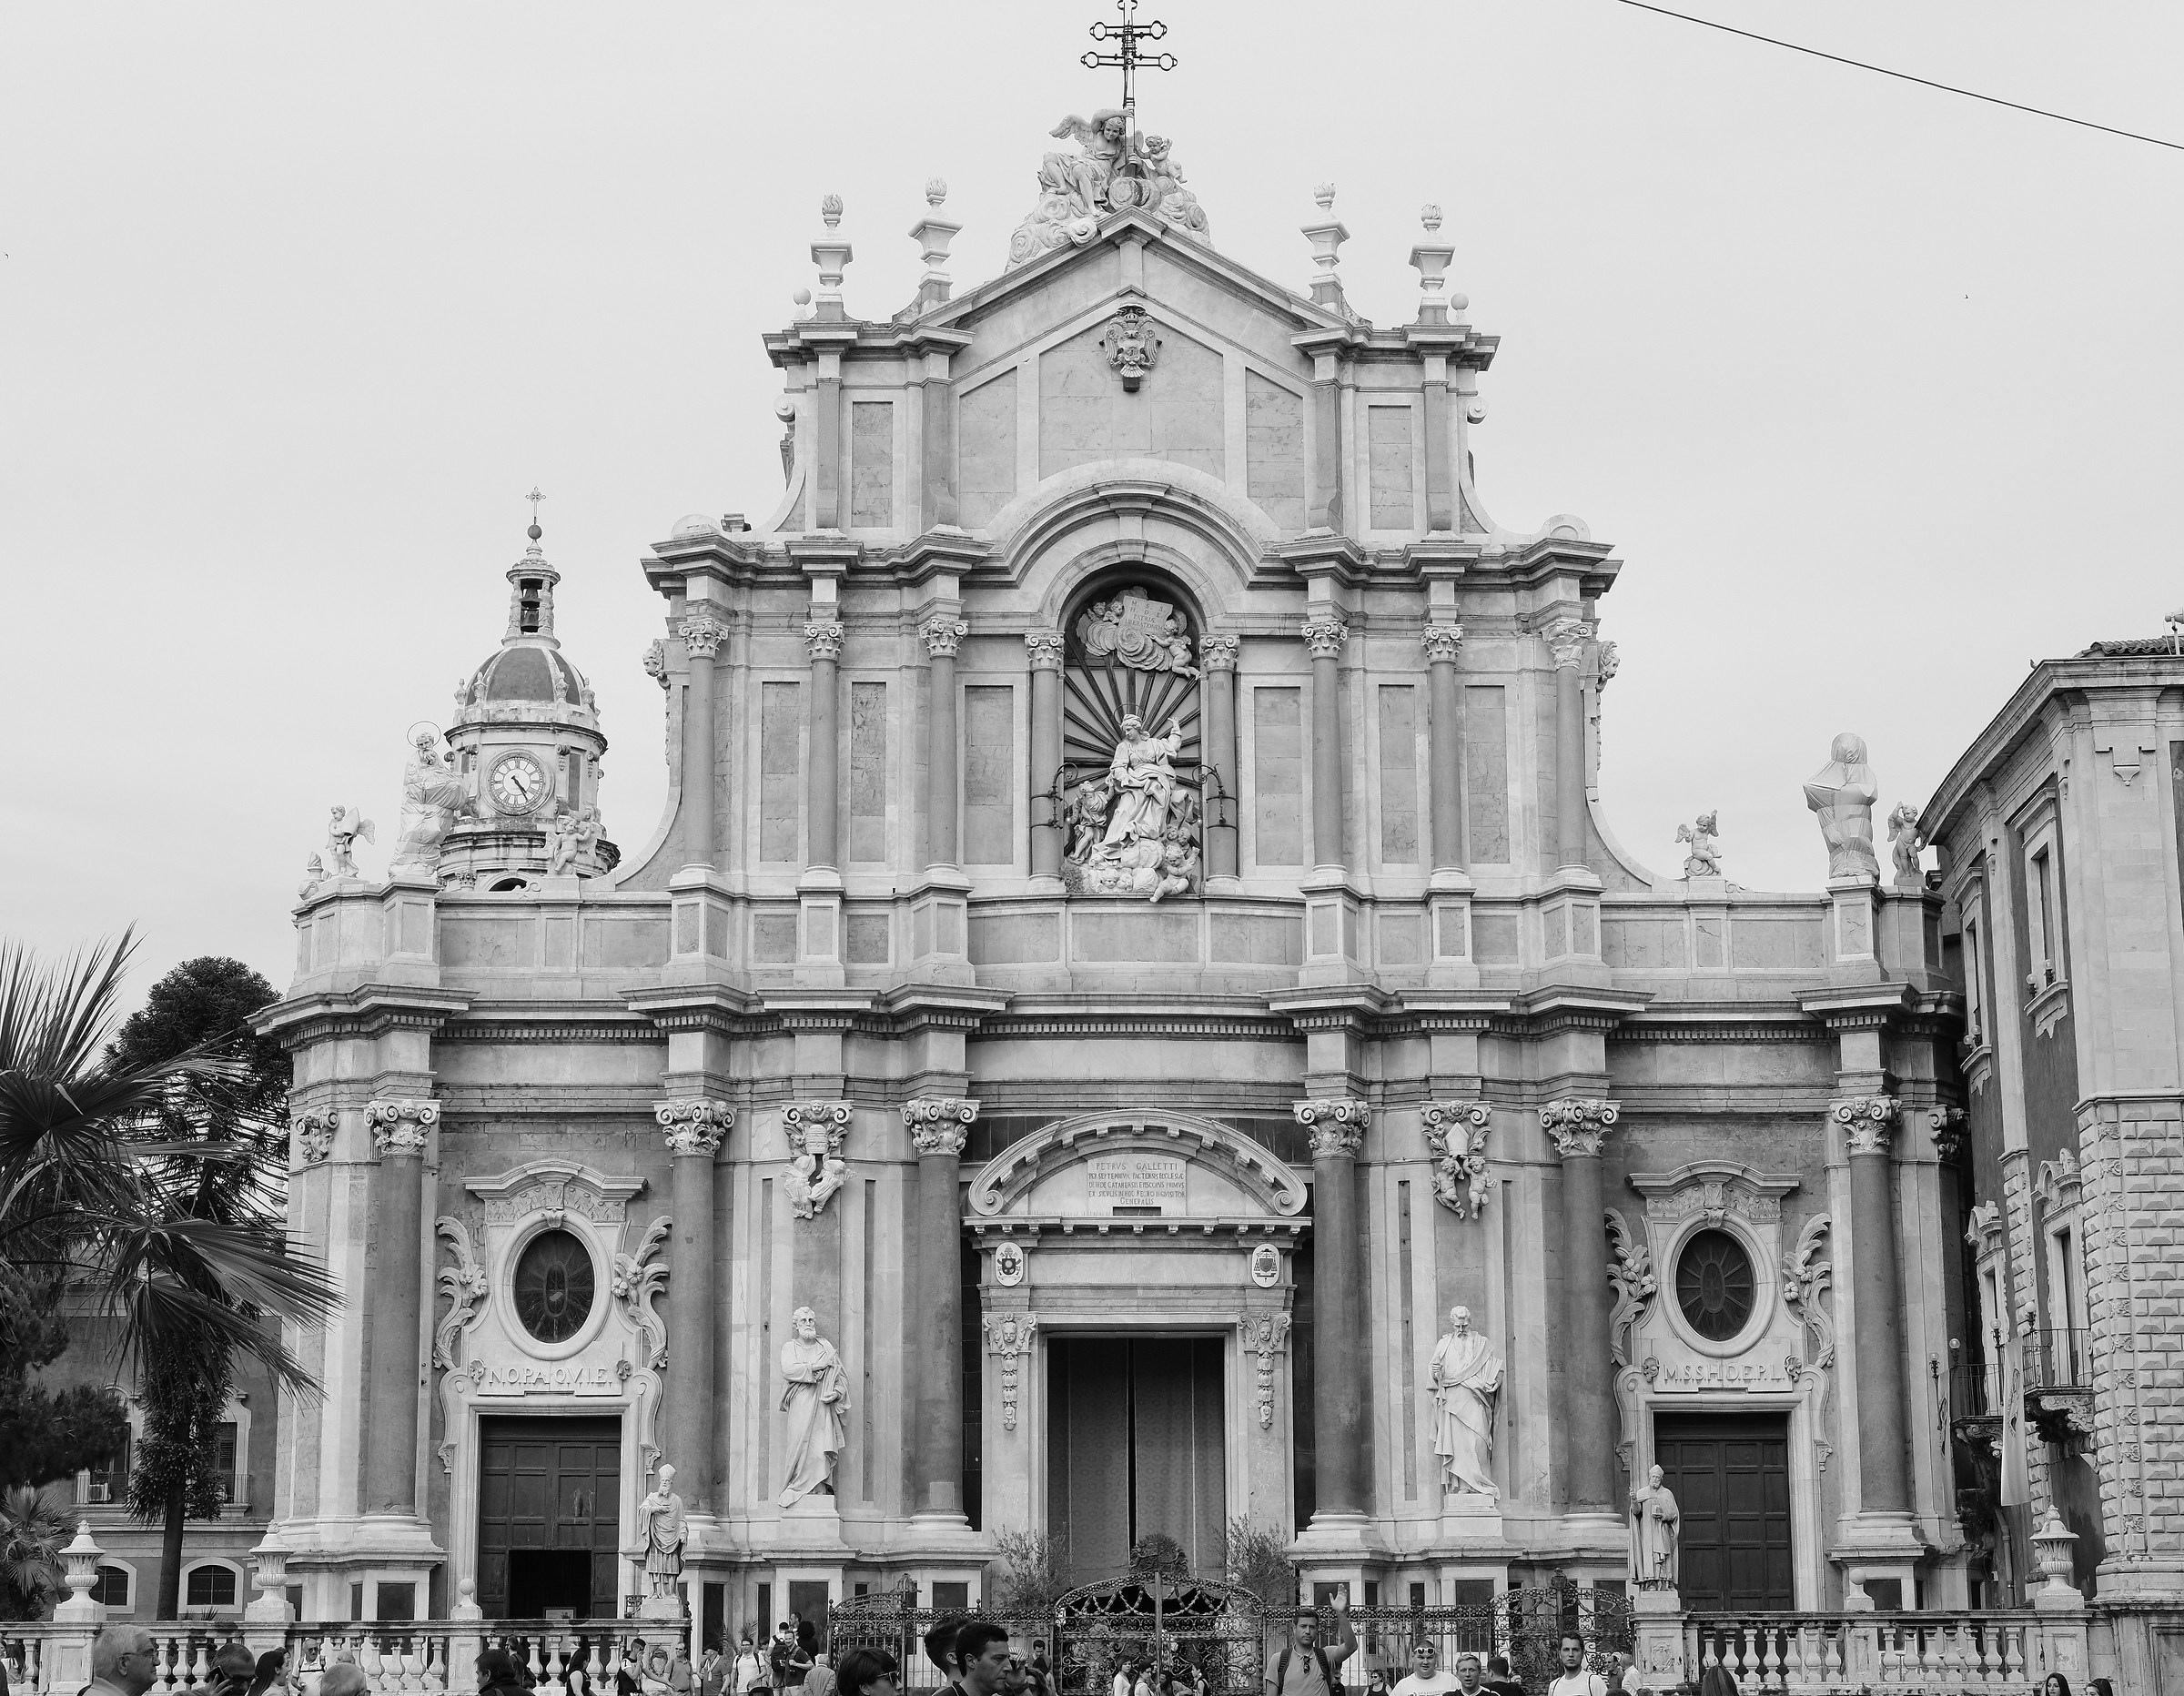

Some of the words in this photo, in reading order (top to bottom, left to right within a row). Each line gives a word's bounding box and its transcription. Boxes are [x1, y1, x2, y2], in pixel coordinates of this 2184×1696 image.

[1096, 1162, 1127, 1171] PETRVS
[1136, 1162, 1178, 1171] GALLETTI
[1119, 1196, 1154, 1206] GENERALIS
